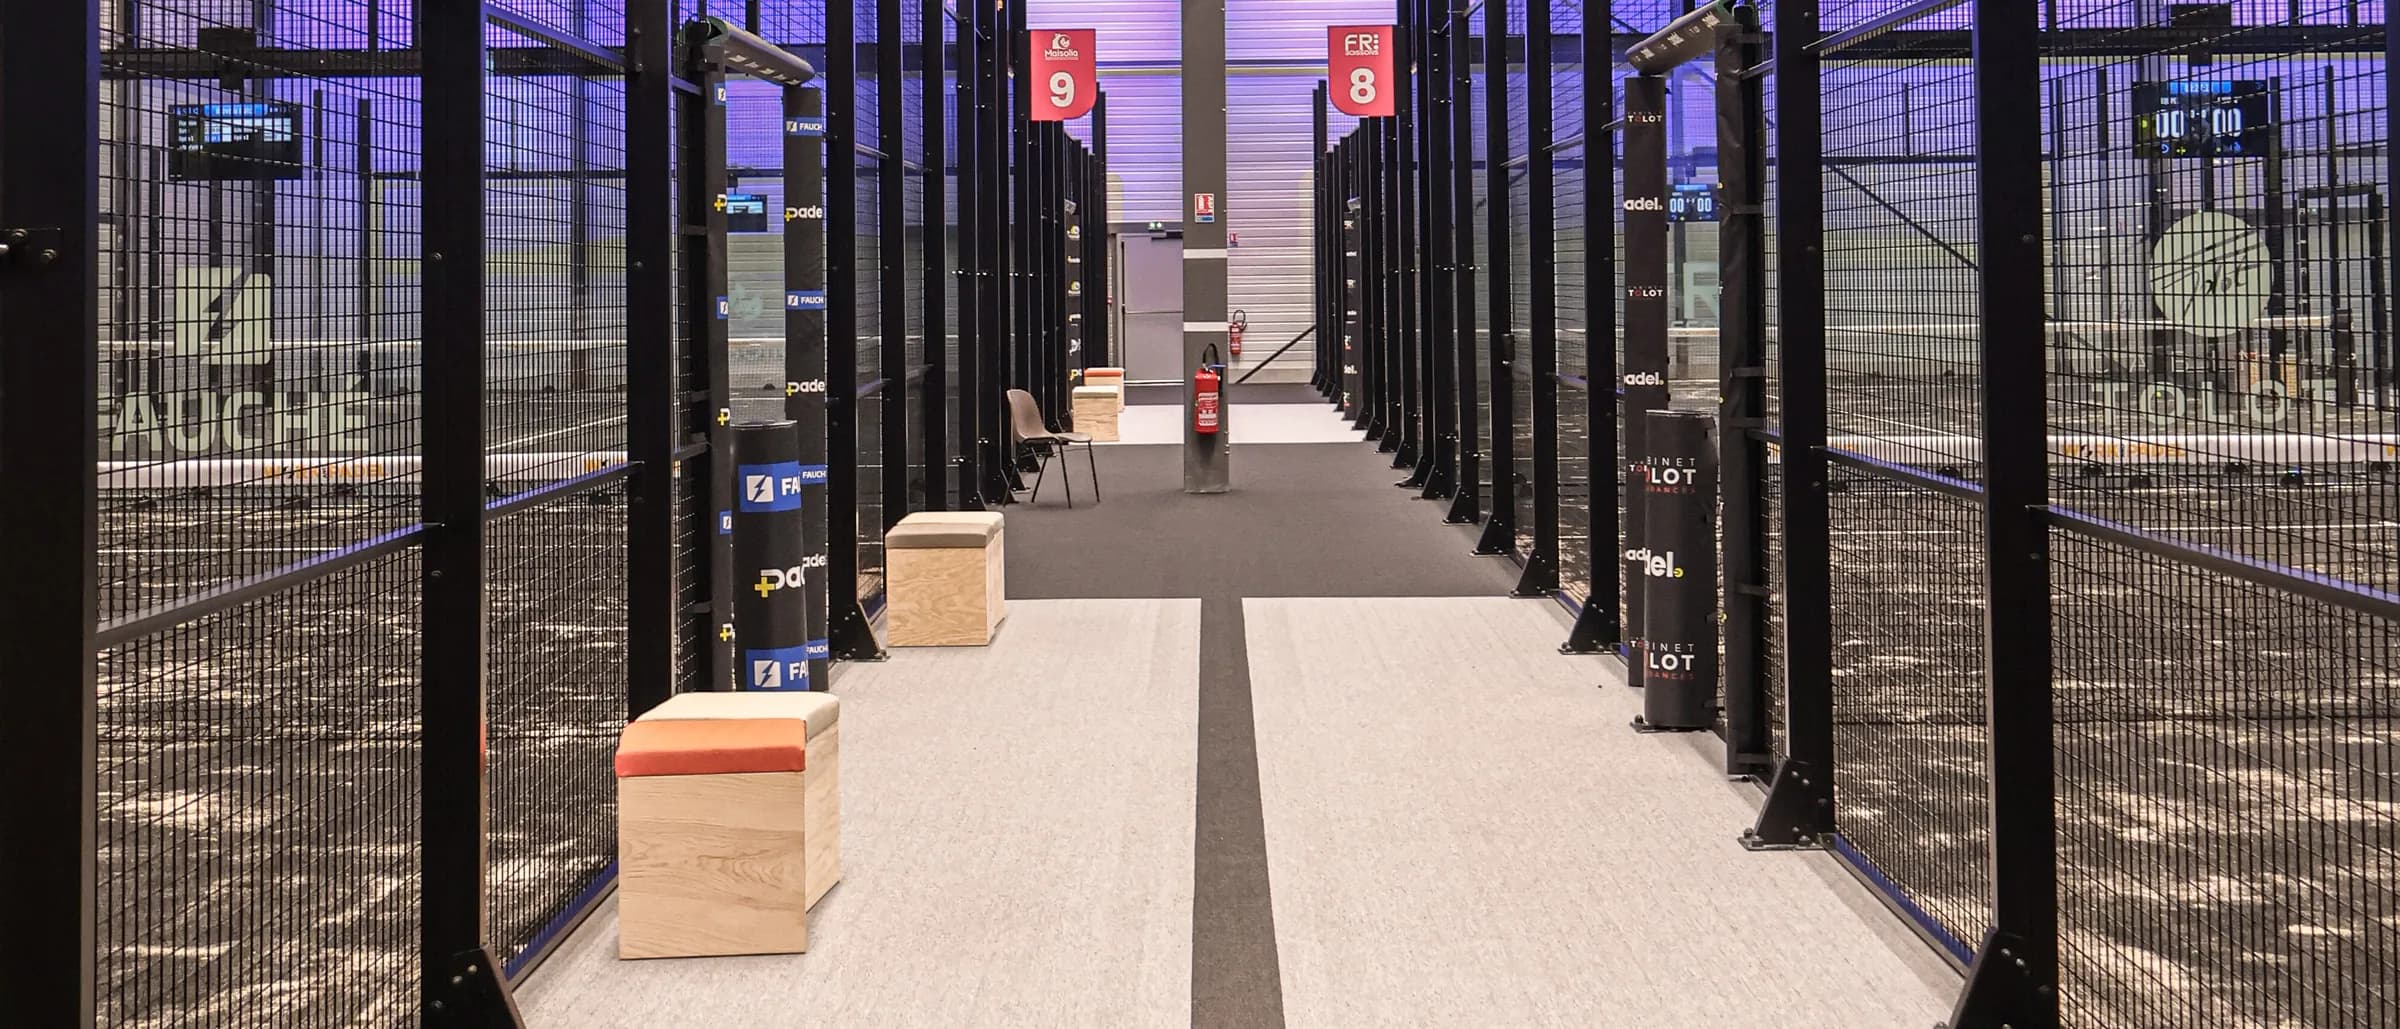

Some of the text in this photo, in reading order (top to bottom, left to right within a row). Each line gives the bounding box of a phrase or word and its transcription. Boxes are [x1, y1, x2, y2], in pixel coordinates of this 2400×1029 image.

[1049, 71, 1075, 107] 9
[1350, 67, 1377, 104] 8
[1627, 115, 1662, 123] TOLOT
[1670, 198, 1684, 213] 00
[1697, 197, 1712, 212] 00
[1628, 289, 1663, 297] TOLOT
